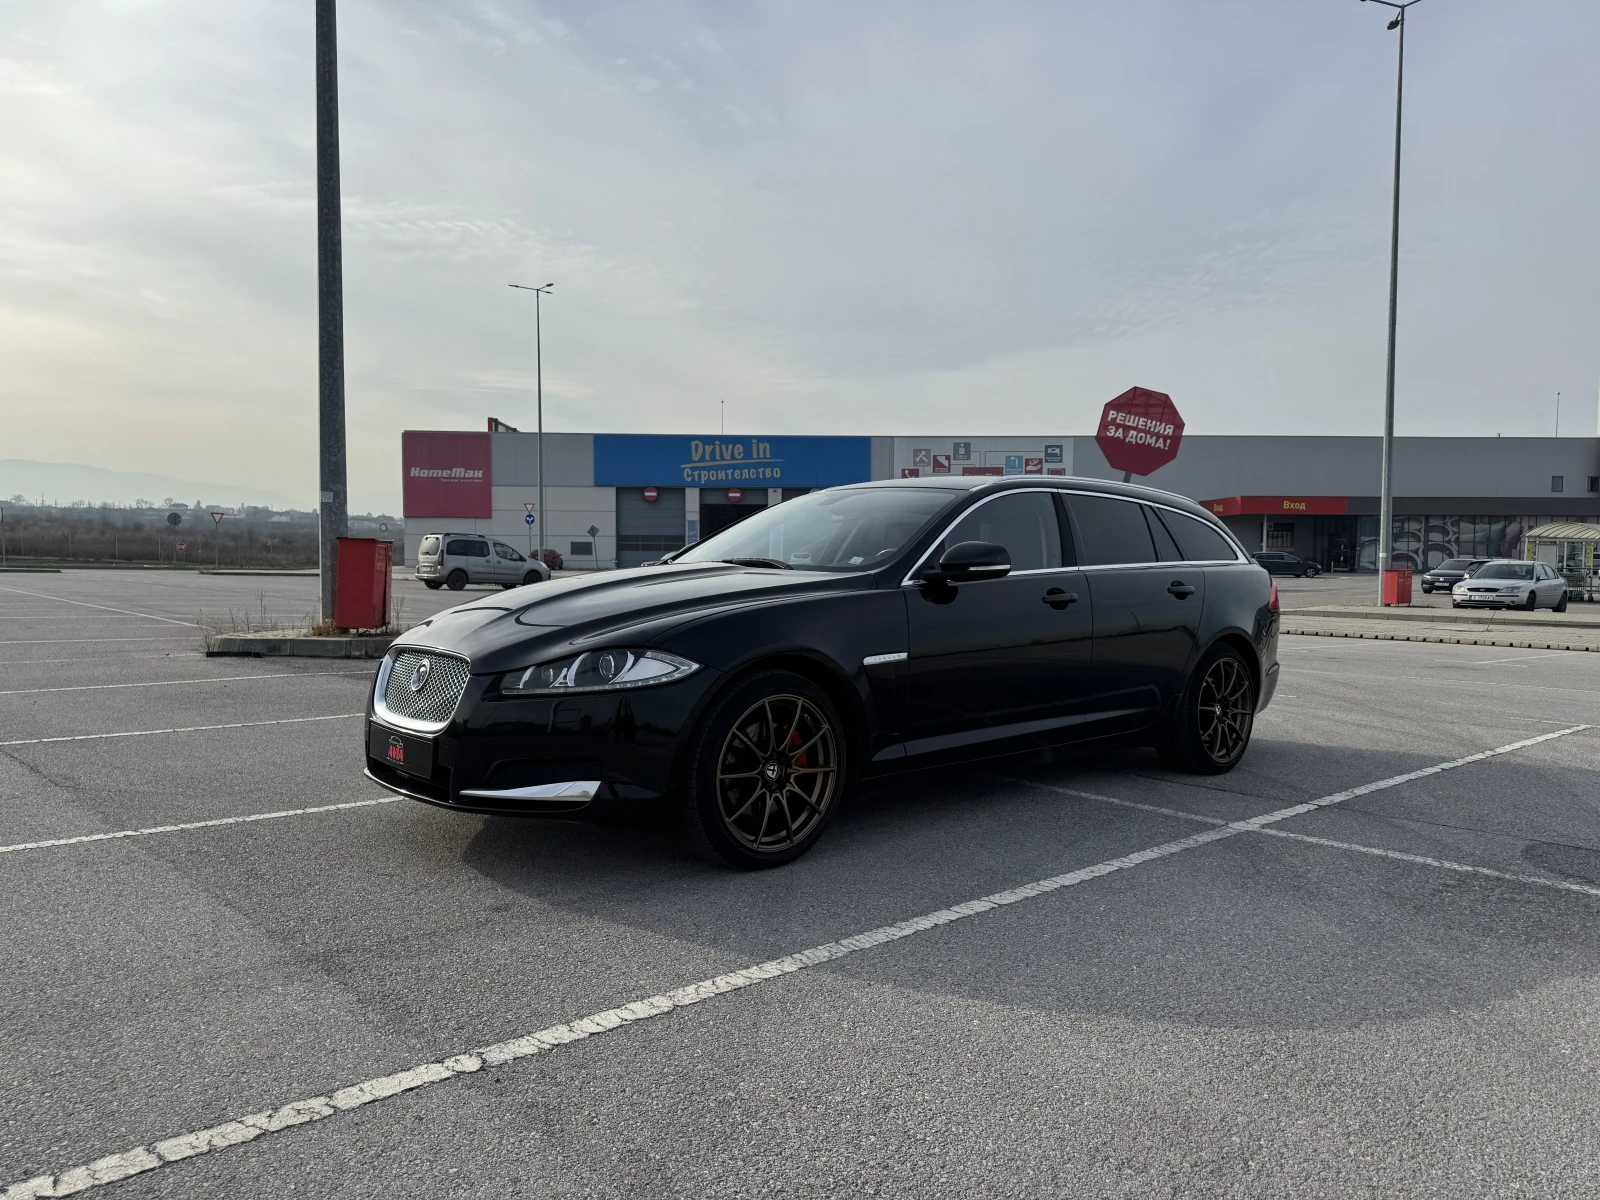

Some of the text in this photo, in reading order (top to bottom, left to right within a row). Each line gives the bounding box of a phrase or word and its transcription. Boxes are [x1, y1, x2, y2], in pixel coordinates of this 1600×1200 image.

[1107, 410, 1174, 436] РЕШЕНИЯ
[1106, 425, 1171, 450] ЗА ДОМА!
[691, 439, 771, 461] Drive in
[410, 467, 483, 478] HomeMax
[683, 467, 781, 484] Строителство
[1283, 501, 1306, 510] Вход
